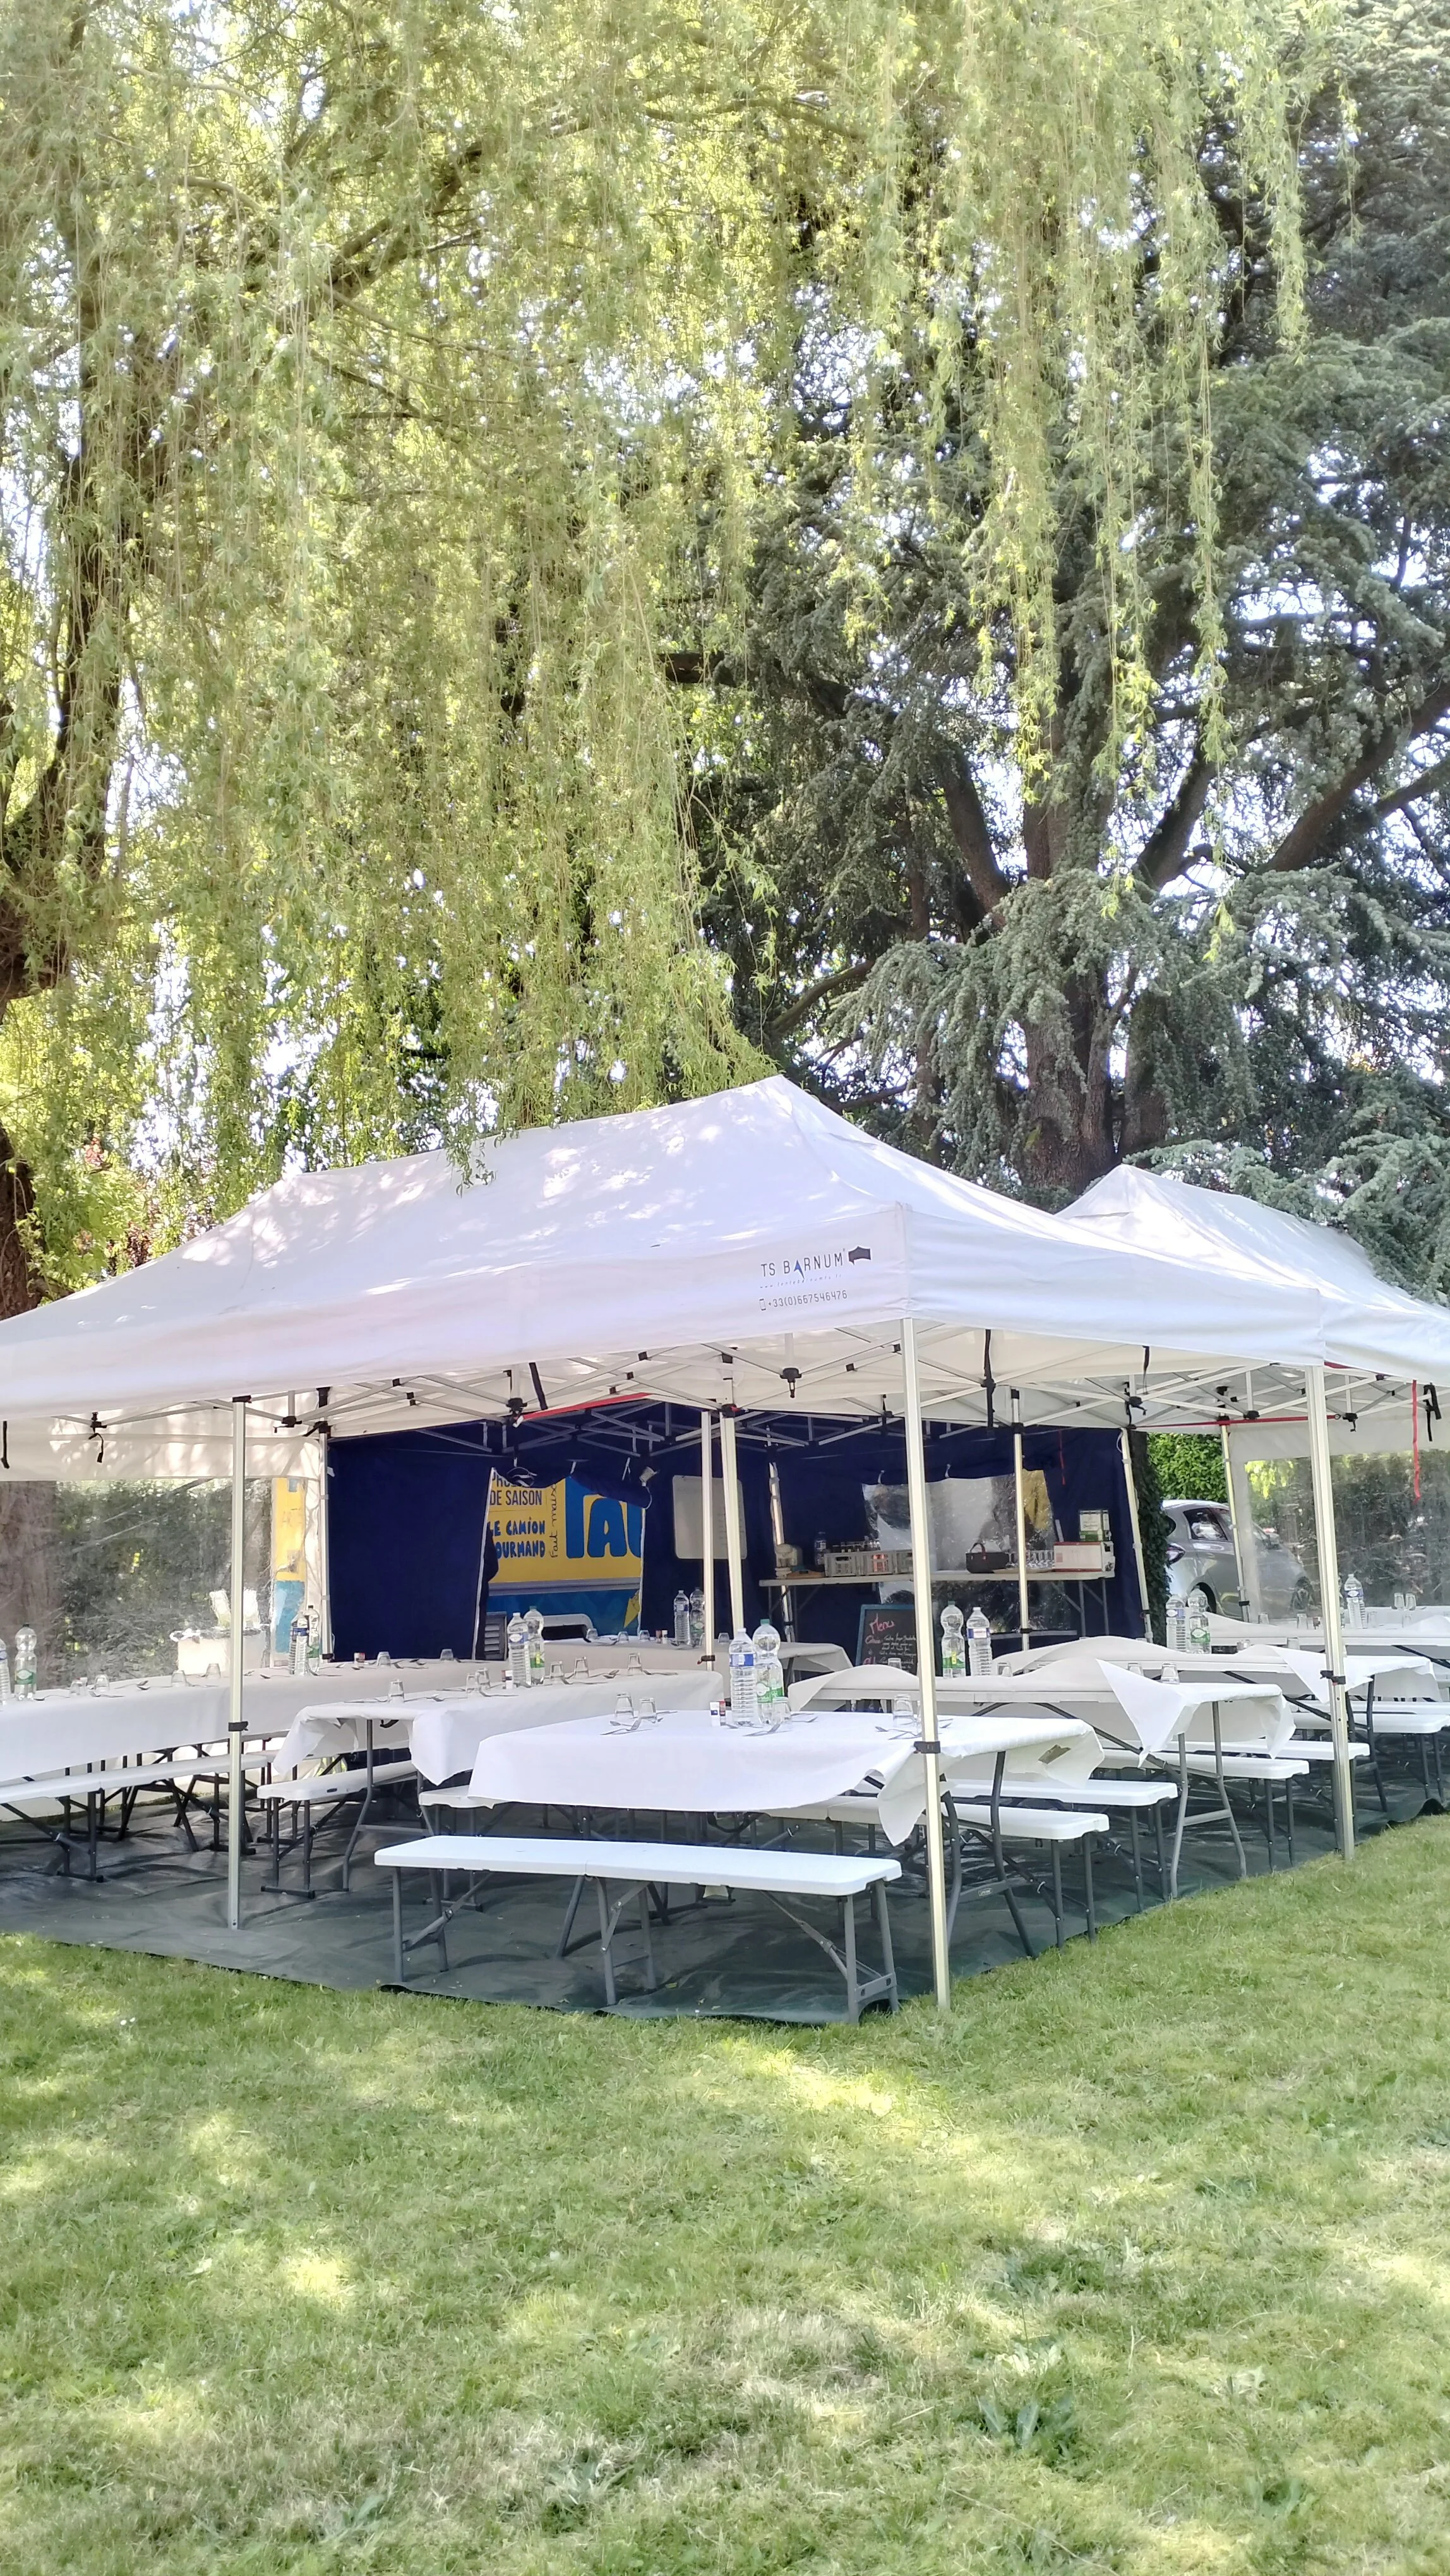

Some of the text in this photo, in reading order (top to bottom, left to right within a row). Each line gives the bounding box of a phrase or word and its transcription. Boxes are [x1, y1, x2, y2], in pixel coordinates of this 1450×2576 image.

[761, 1252, 843, 1279] TS BARNUM
[768, 1289, 848, 1308] +33(0)667546476
[489, 1490, 542, 1505] DE SAISON
[549, 1484, 558, 1558] Fait maiso
[494, 1540, 546, 1558] OURMAND
